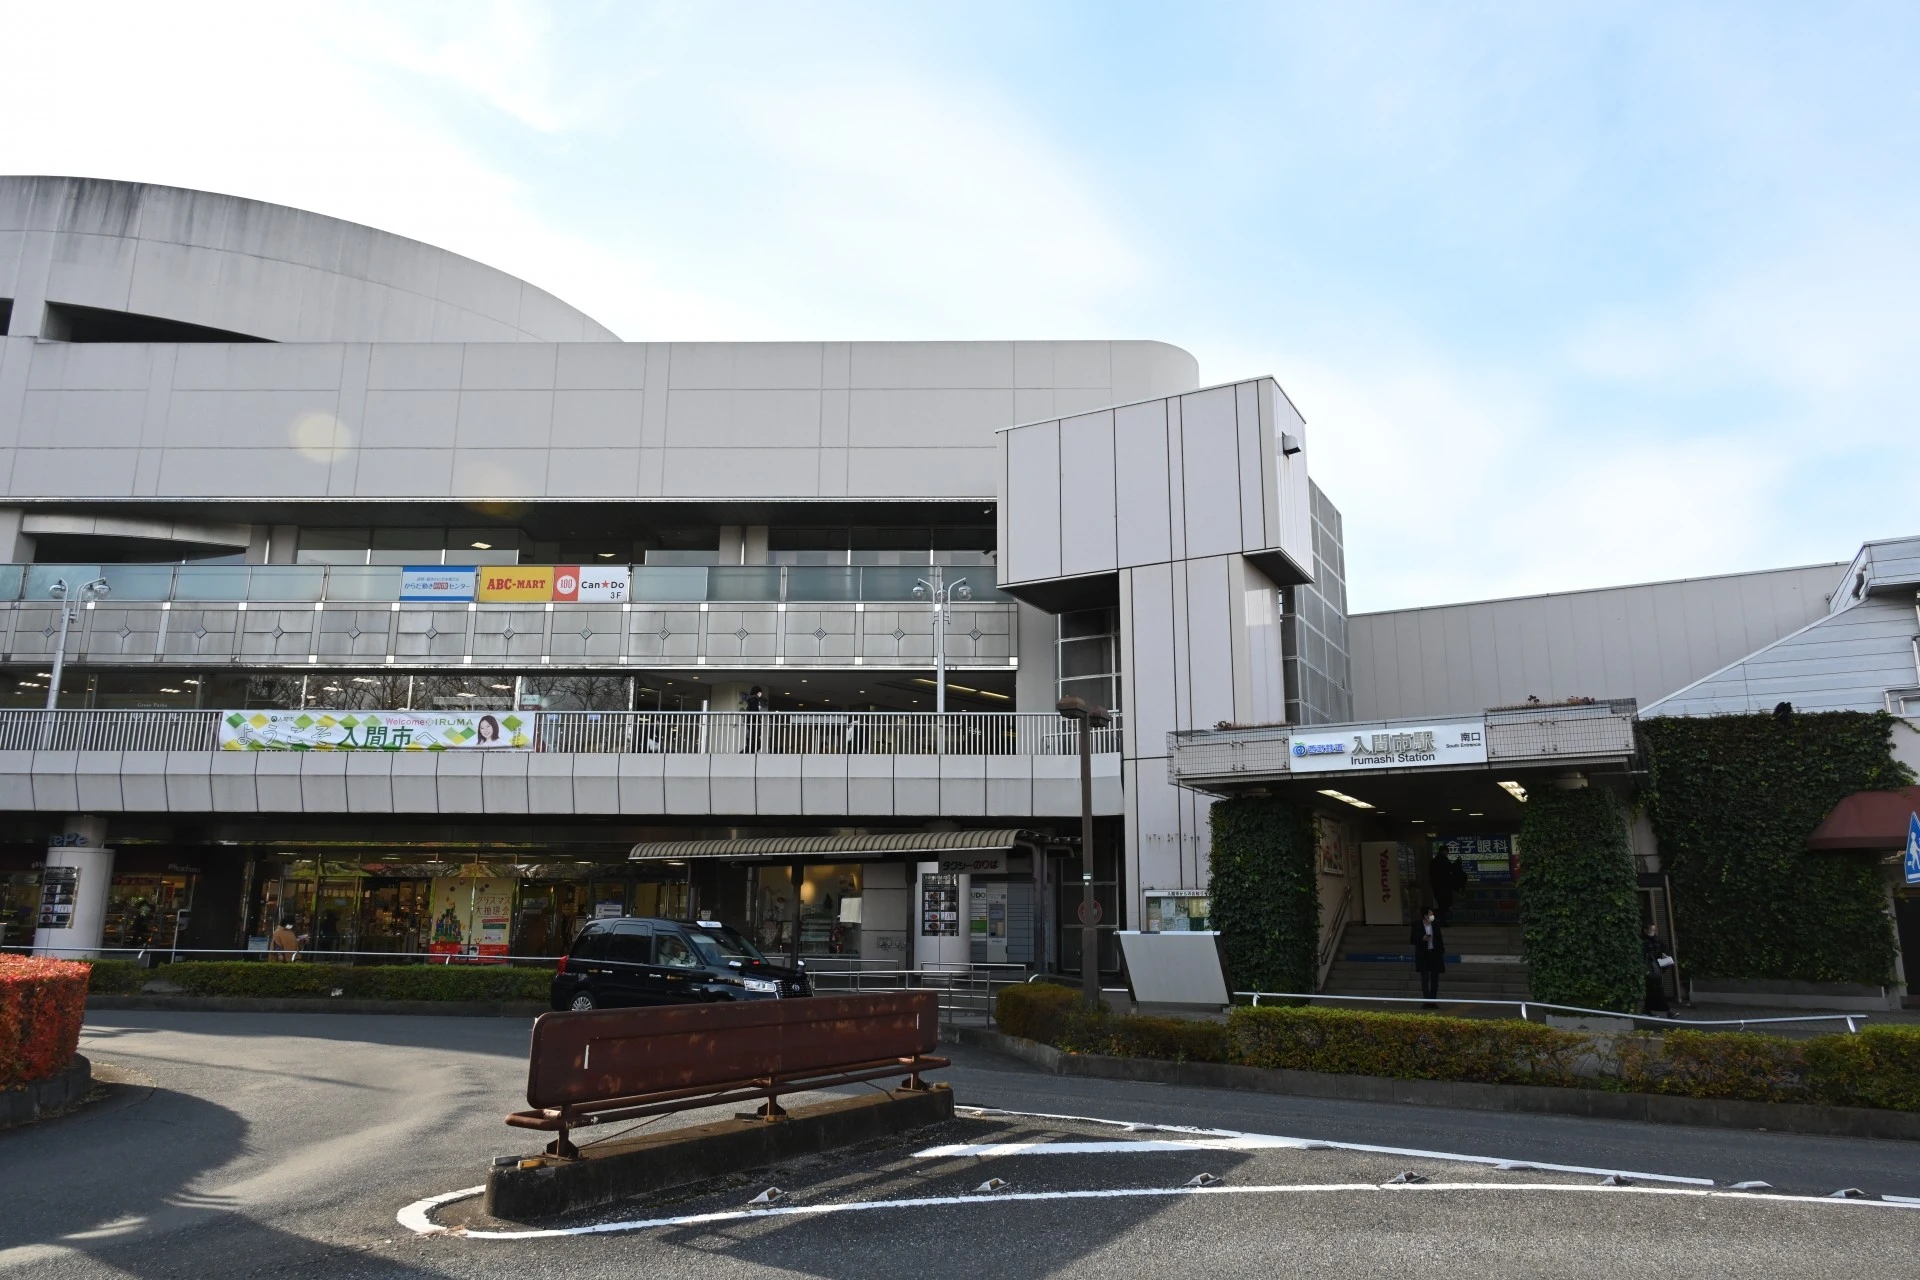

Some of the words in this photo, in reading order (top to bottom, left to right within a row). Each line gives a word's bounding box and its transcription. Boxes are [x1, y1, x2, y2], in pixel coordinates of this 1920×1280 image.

[487, 578, 546, 590] ABC-MART
[560, 578, 573, 589] 100
[610, 591, 622, 599] 3F
[385, 716, 425, 726] Welcome
[1460, 732, 1481, 742] 南口
[1308, 743, 1345, 754] 西武鉄道
[1352, 731, 1435, 755] 入間市駅
[1350, 753, 1395, 766] Irumashi
[1397, 751, 1436, 764] Station
[1446, 839, 1509, 854] 金子眼科
[943, 860, 999, 871] タクシーのりば
[1379, 848, 1391, 903] Yakult
[476, 896, 511, 906] クリスマス
